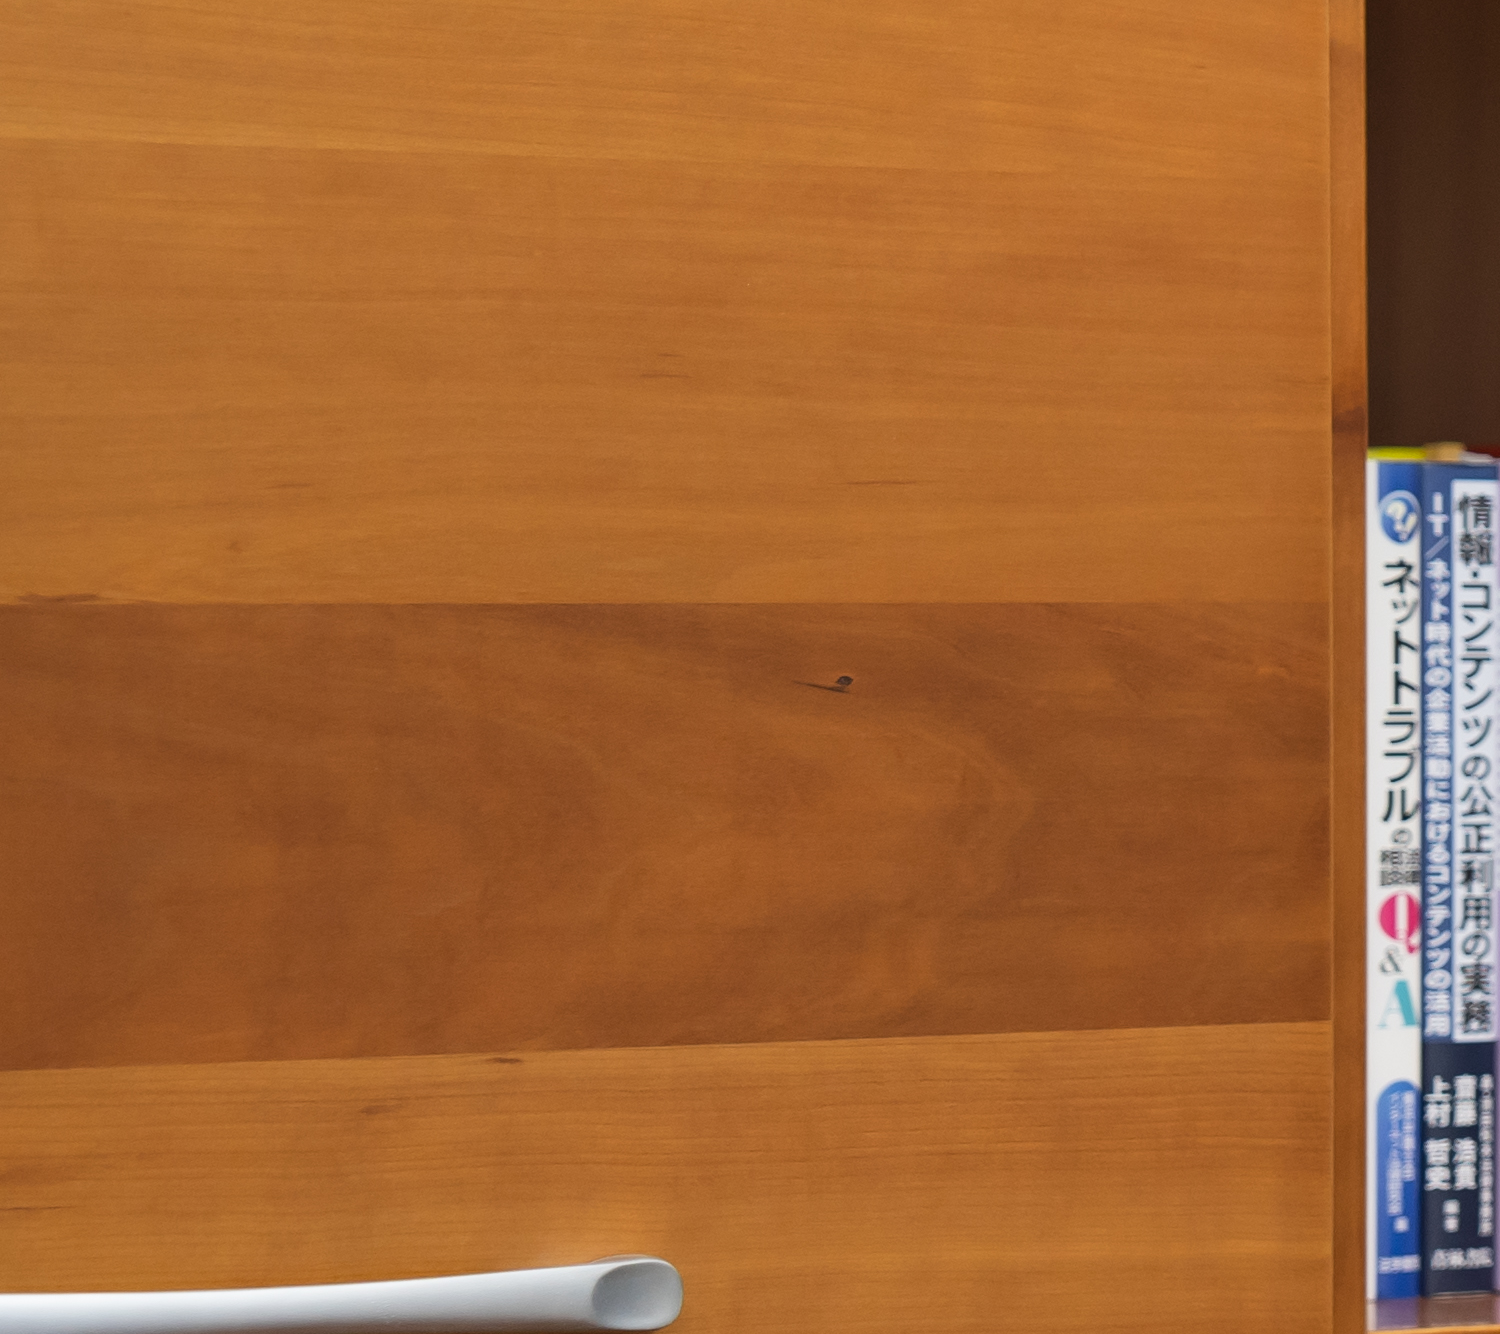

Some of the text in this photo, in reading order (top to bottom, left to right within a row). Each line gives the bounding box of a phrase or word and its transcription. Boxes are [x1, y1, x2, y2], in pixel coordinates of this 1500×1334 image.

[1458, 493, 1494, 1036] 情報・コンテンツの公正利用の実務
